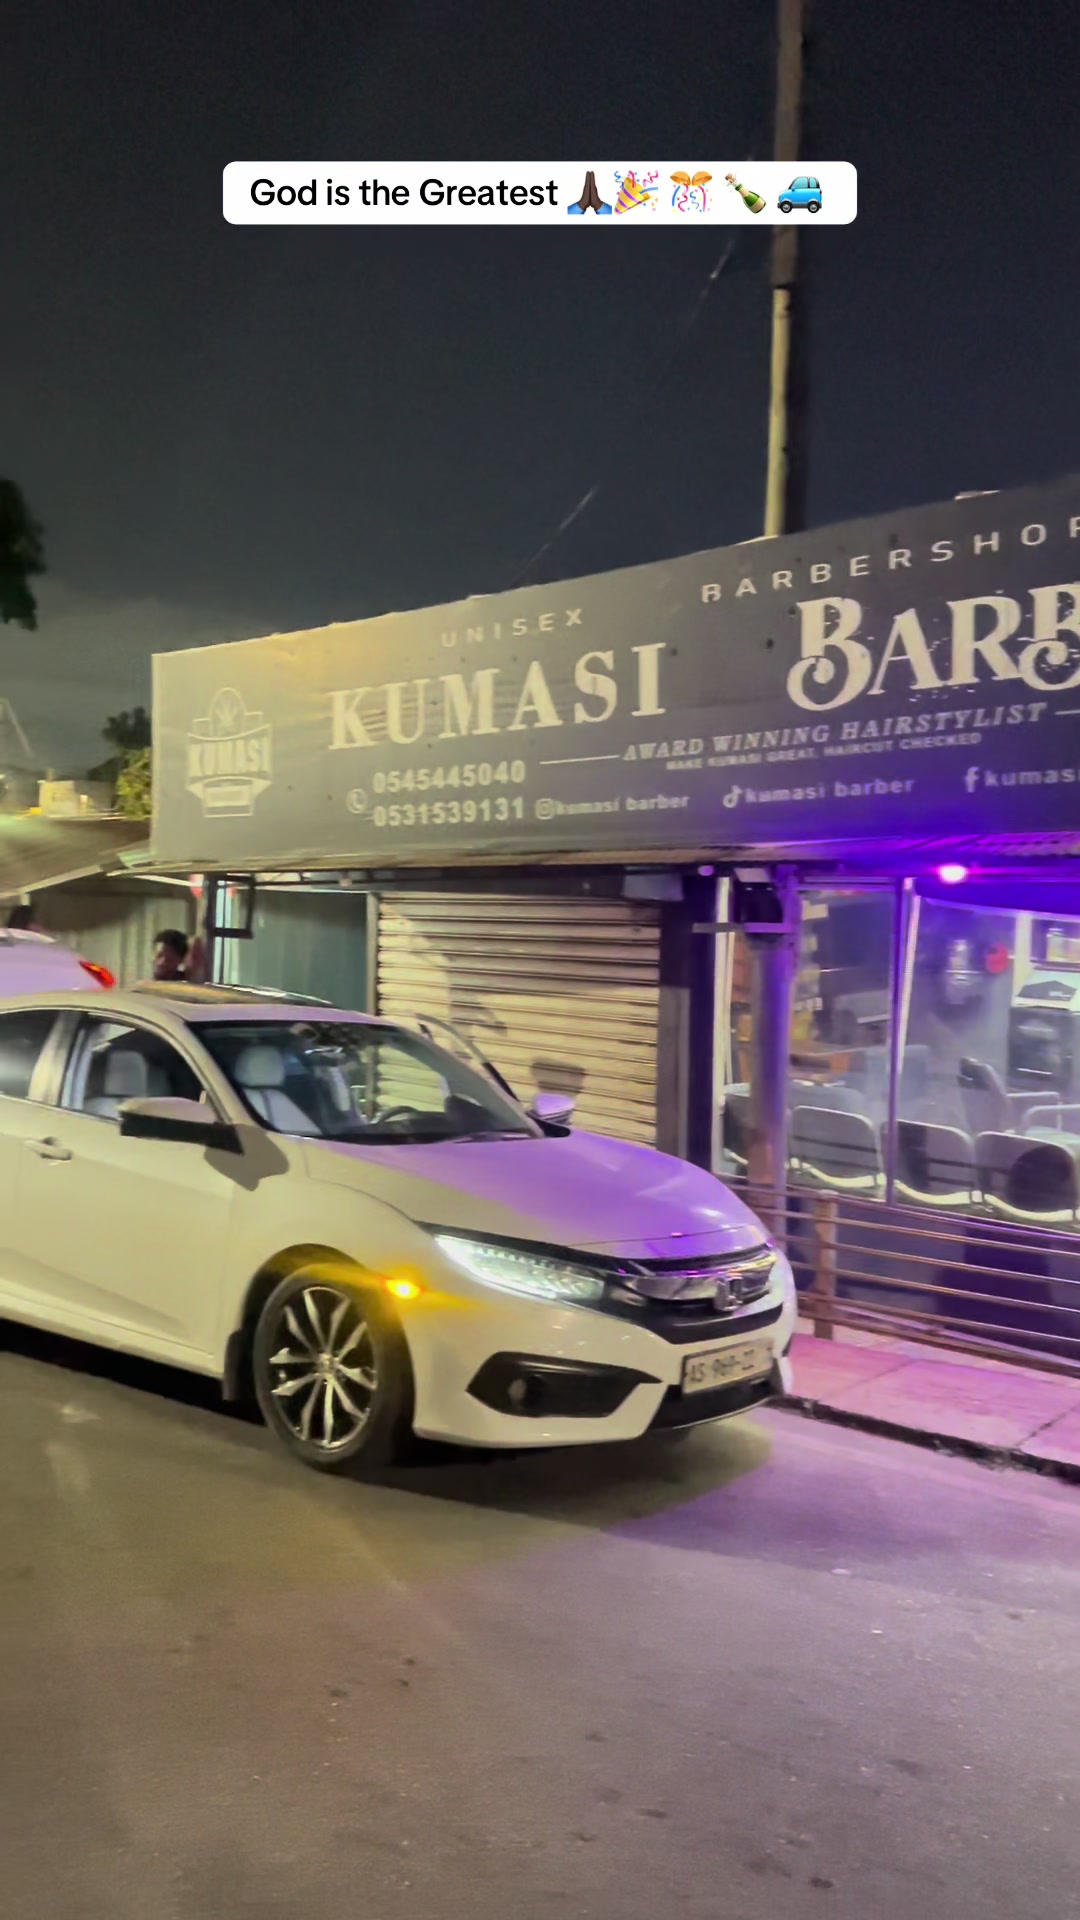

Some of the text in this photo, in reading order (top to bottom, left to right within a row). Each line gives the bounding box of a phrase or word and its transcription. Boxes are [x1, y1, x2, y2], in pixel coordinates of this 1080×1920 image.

[441, 607, 585, 648] UNISEX
[328, 642, 667, 750] KUMASI
[623, 702, 1048, 761] AWARD WINNING HAIRSTYLIST
[824, 740, 894, 757] HAIRCUT
[900, 732, 982, 750] CHECKED
[188, 736, 272, 777] KUMASI
[372, 759, 526, 794] 0545445040
[745, 778, 915, 803] kumasi barber
[373, 796, 524, 827] 0531539131
[556, 794, 690, 815] kumasi barber
